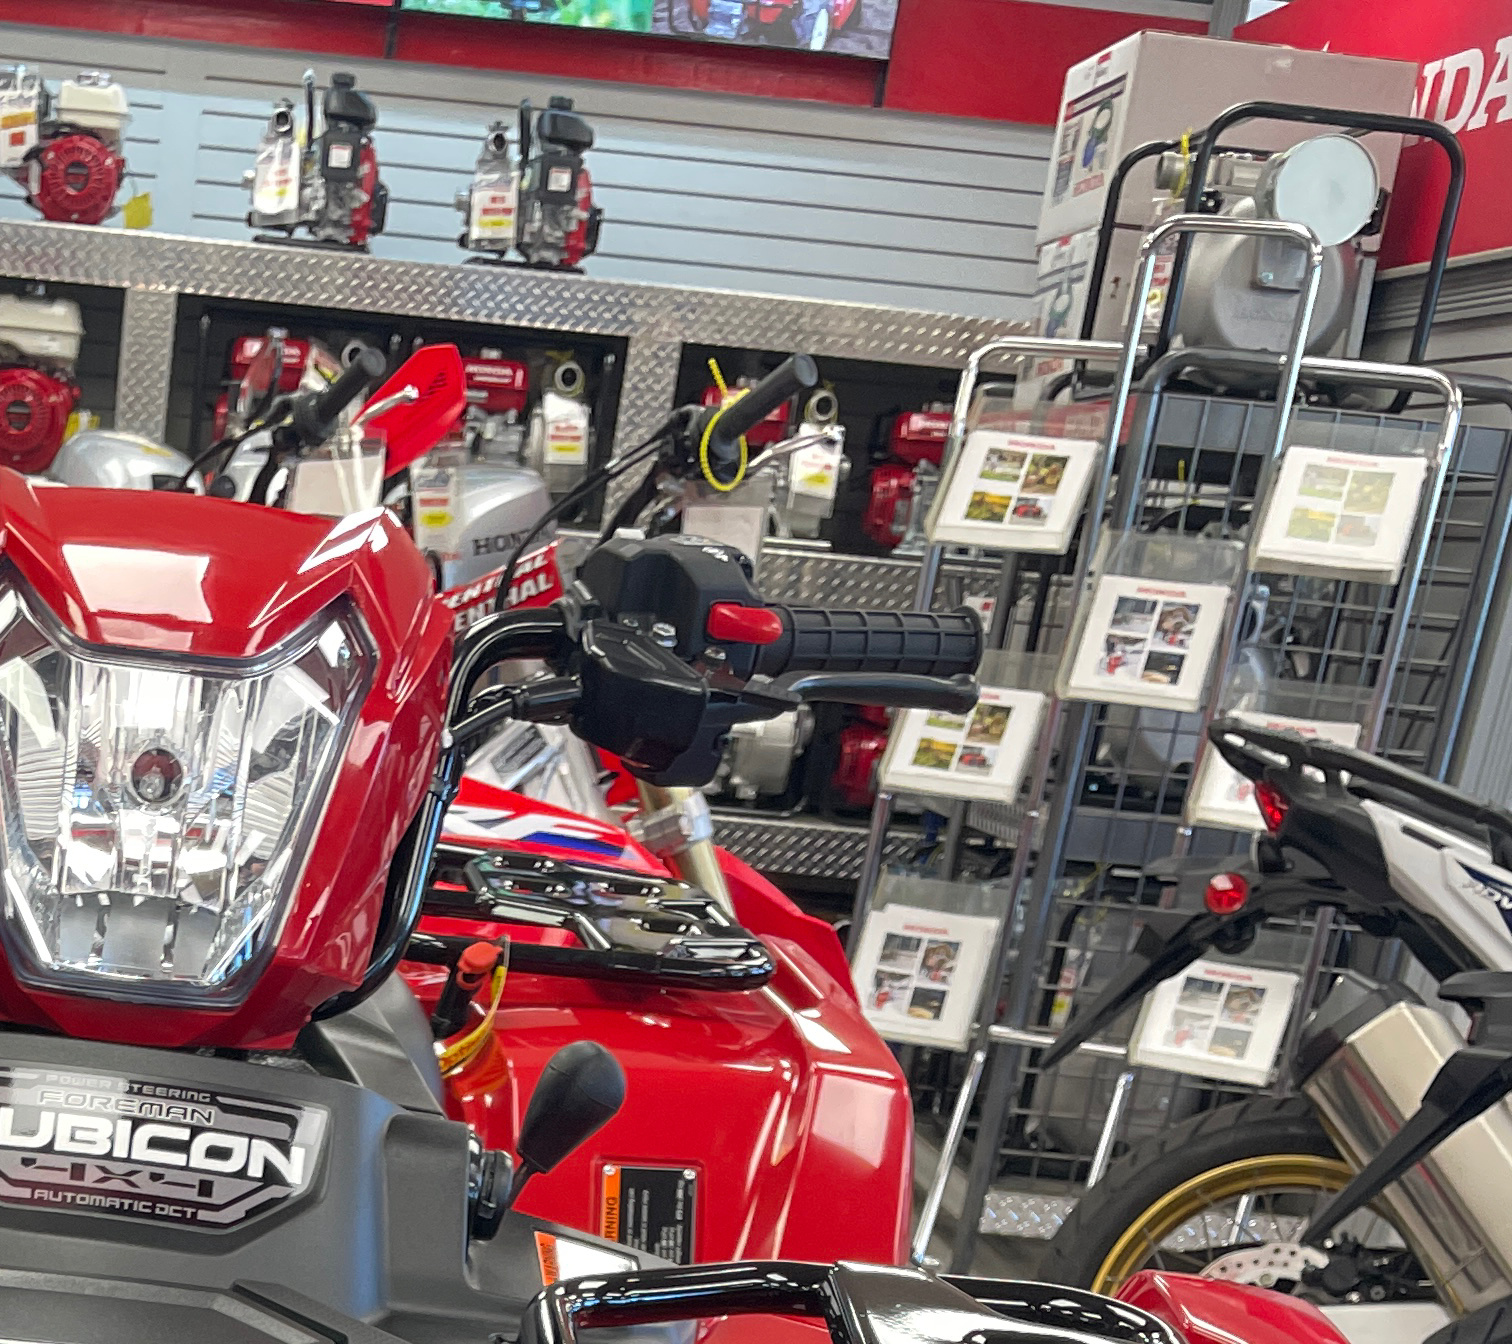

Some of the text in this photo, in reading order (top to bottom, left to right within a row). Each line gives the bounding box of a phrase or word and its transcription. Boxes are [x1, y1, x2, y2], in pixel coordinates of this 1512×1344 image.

[45, 1073, 211, 1102] POWER STEERING
[38, 1088, 215, 1125] FOREMAN
[31, 1187, 197, 1219] AUTOMATIC DCT
